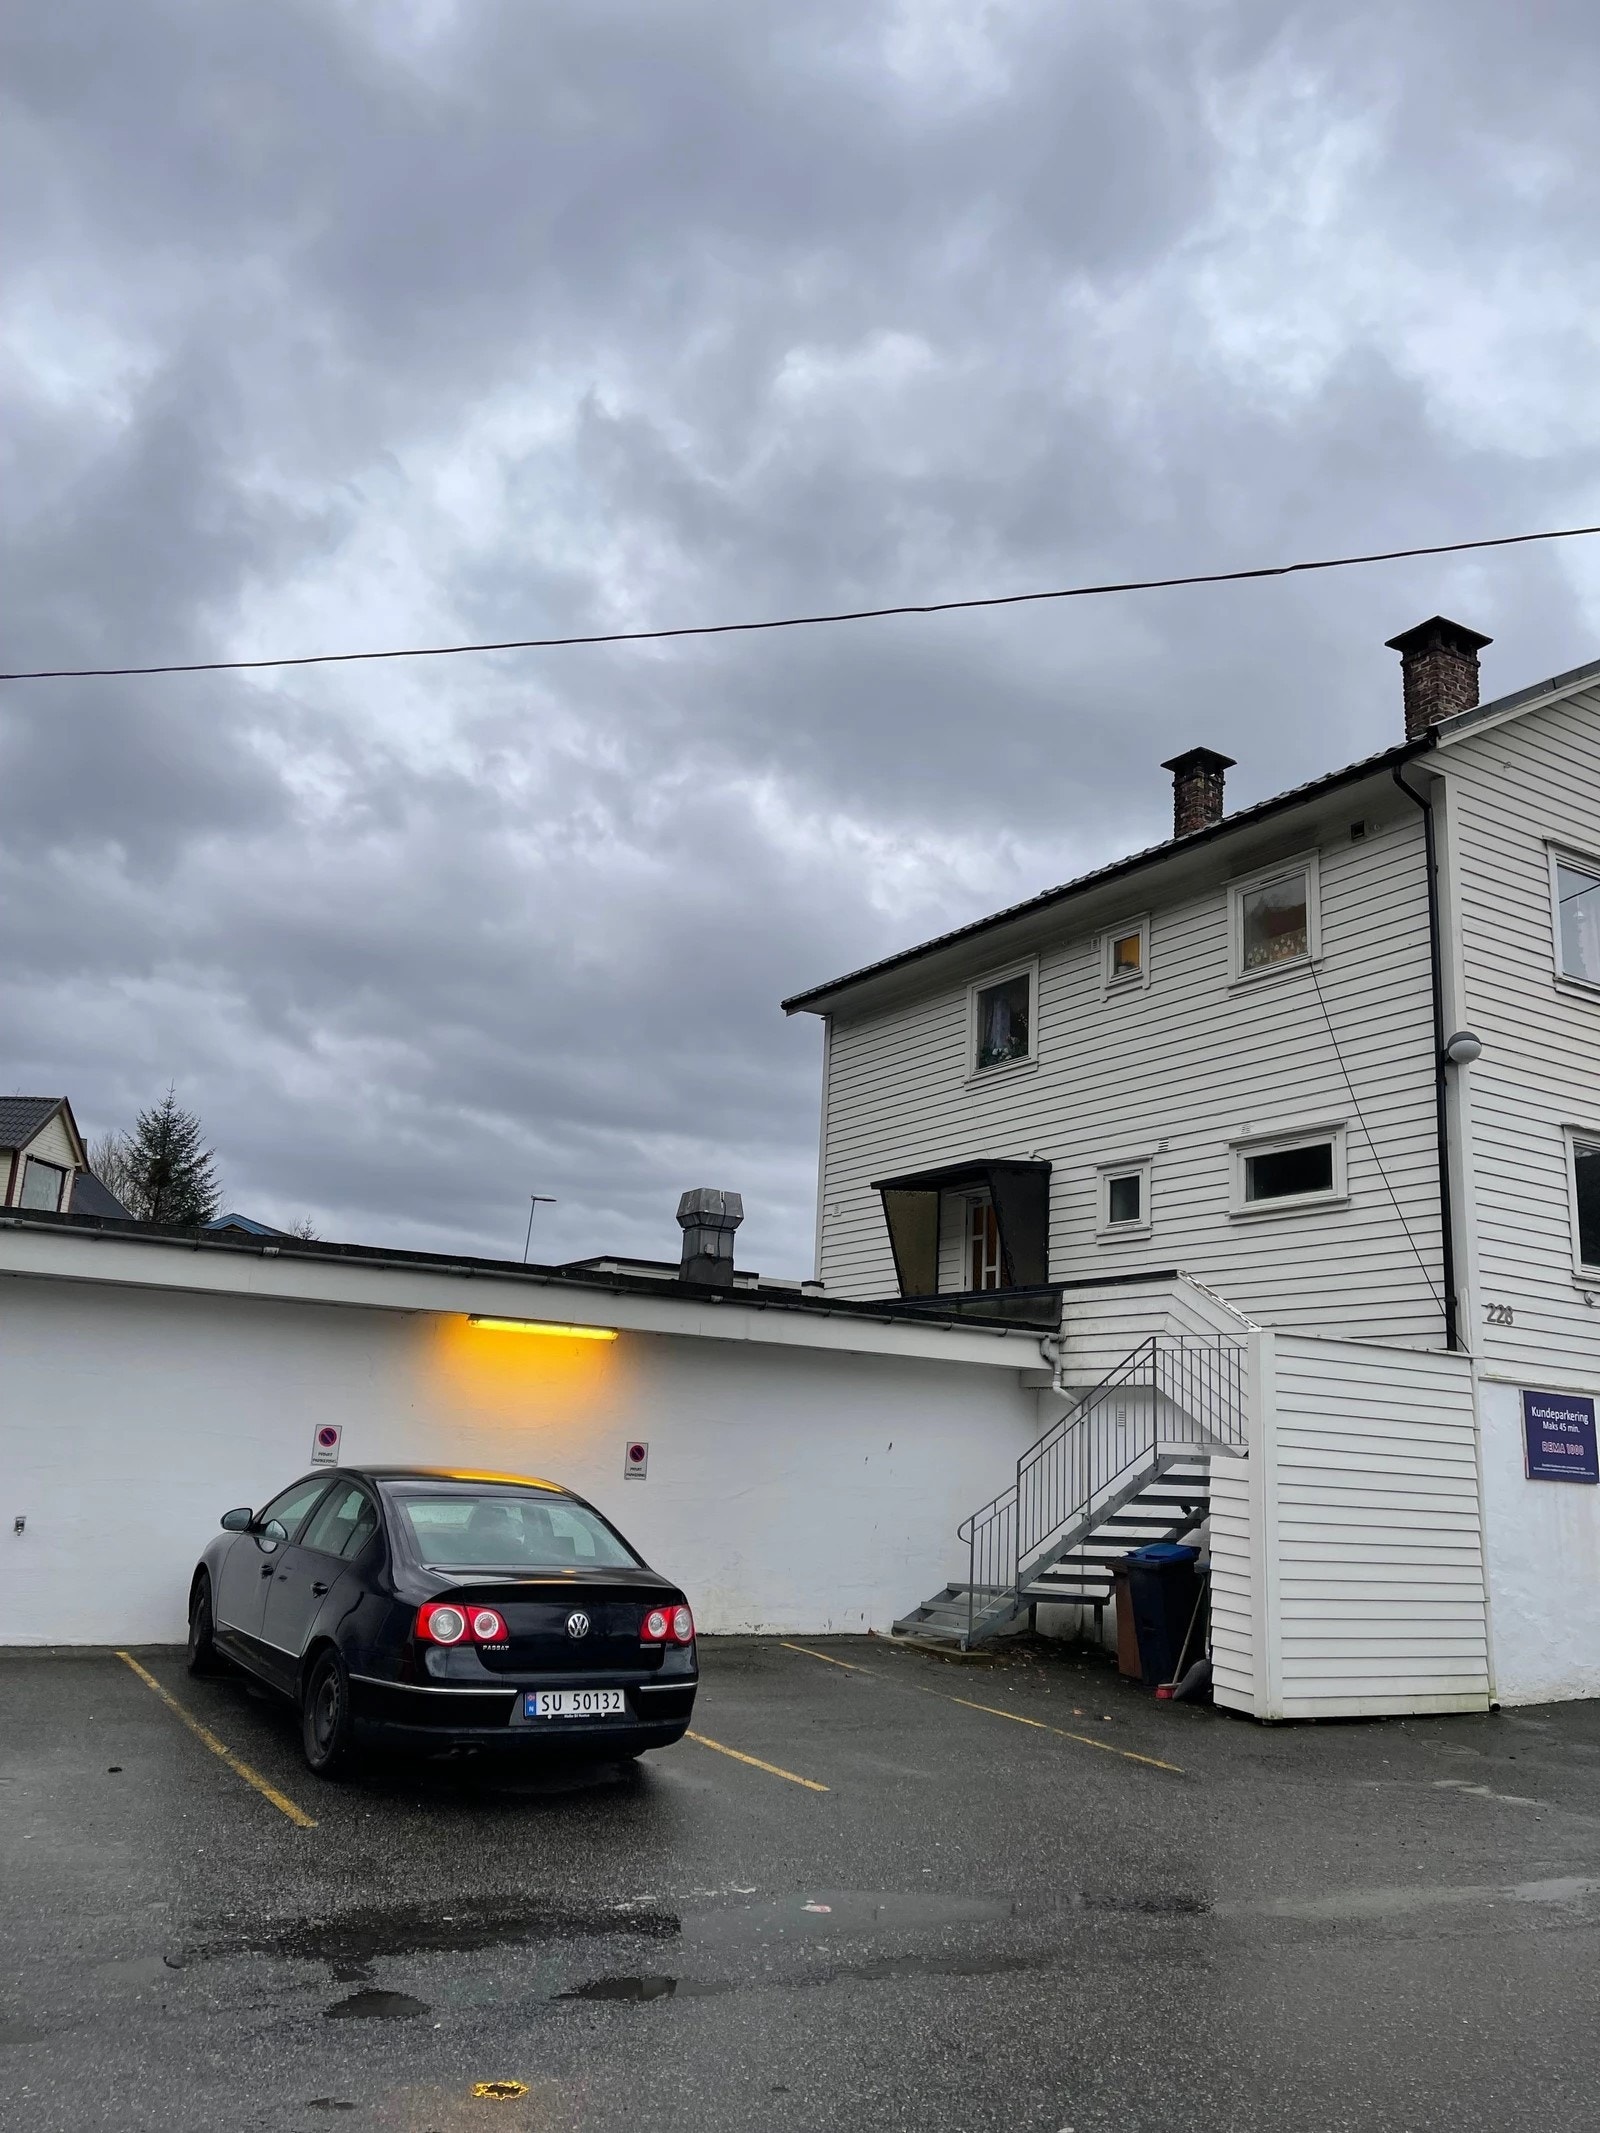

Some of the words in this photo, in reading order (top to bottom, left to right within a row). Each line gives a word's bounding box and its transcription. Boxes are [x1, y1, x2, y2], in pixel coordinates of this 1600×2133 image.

[1487, 1303, 1513, 1325] 228
[1531, 1406, 1588, 1425] Kundeparkering
[1543, 1421, 1558, 1431] Maks
[1559, 1423, 1566, 1431] 45
[1568, 1424, 1580, 1433] min.
[1542, 1441, 1565, 1454] REMA
[1566, 1443, 1584, 1456] 1000
[542, 1694, 562, 1712] SU
[573, 1692, 620, 1711] 50132
